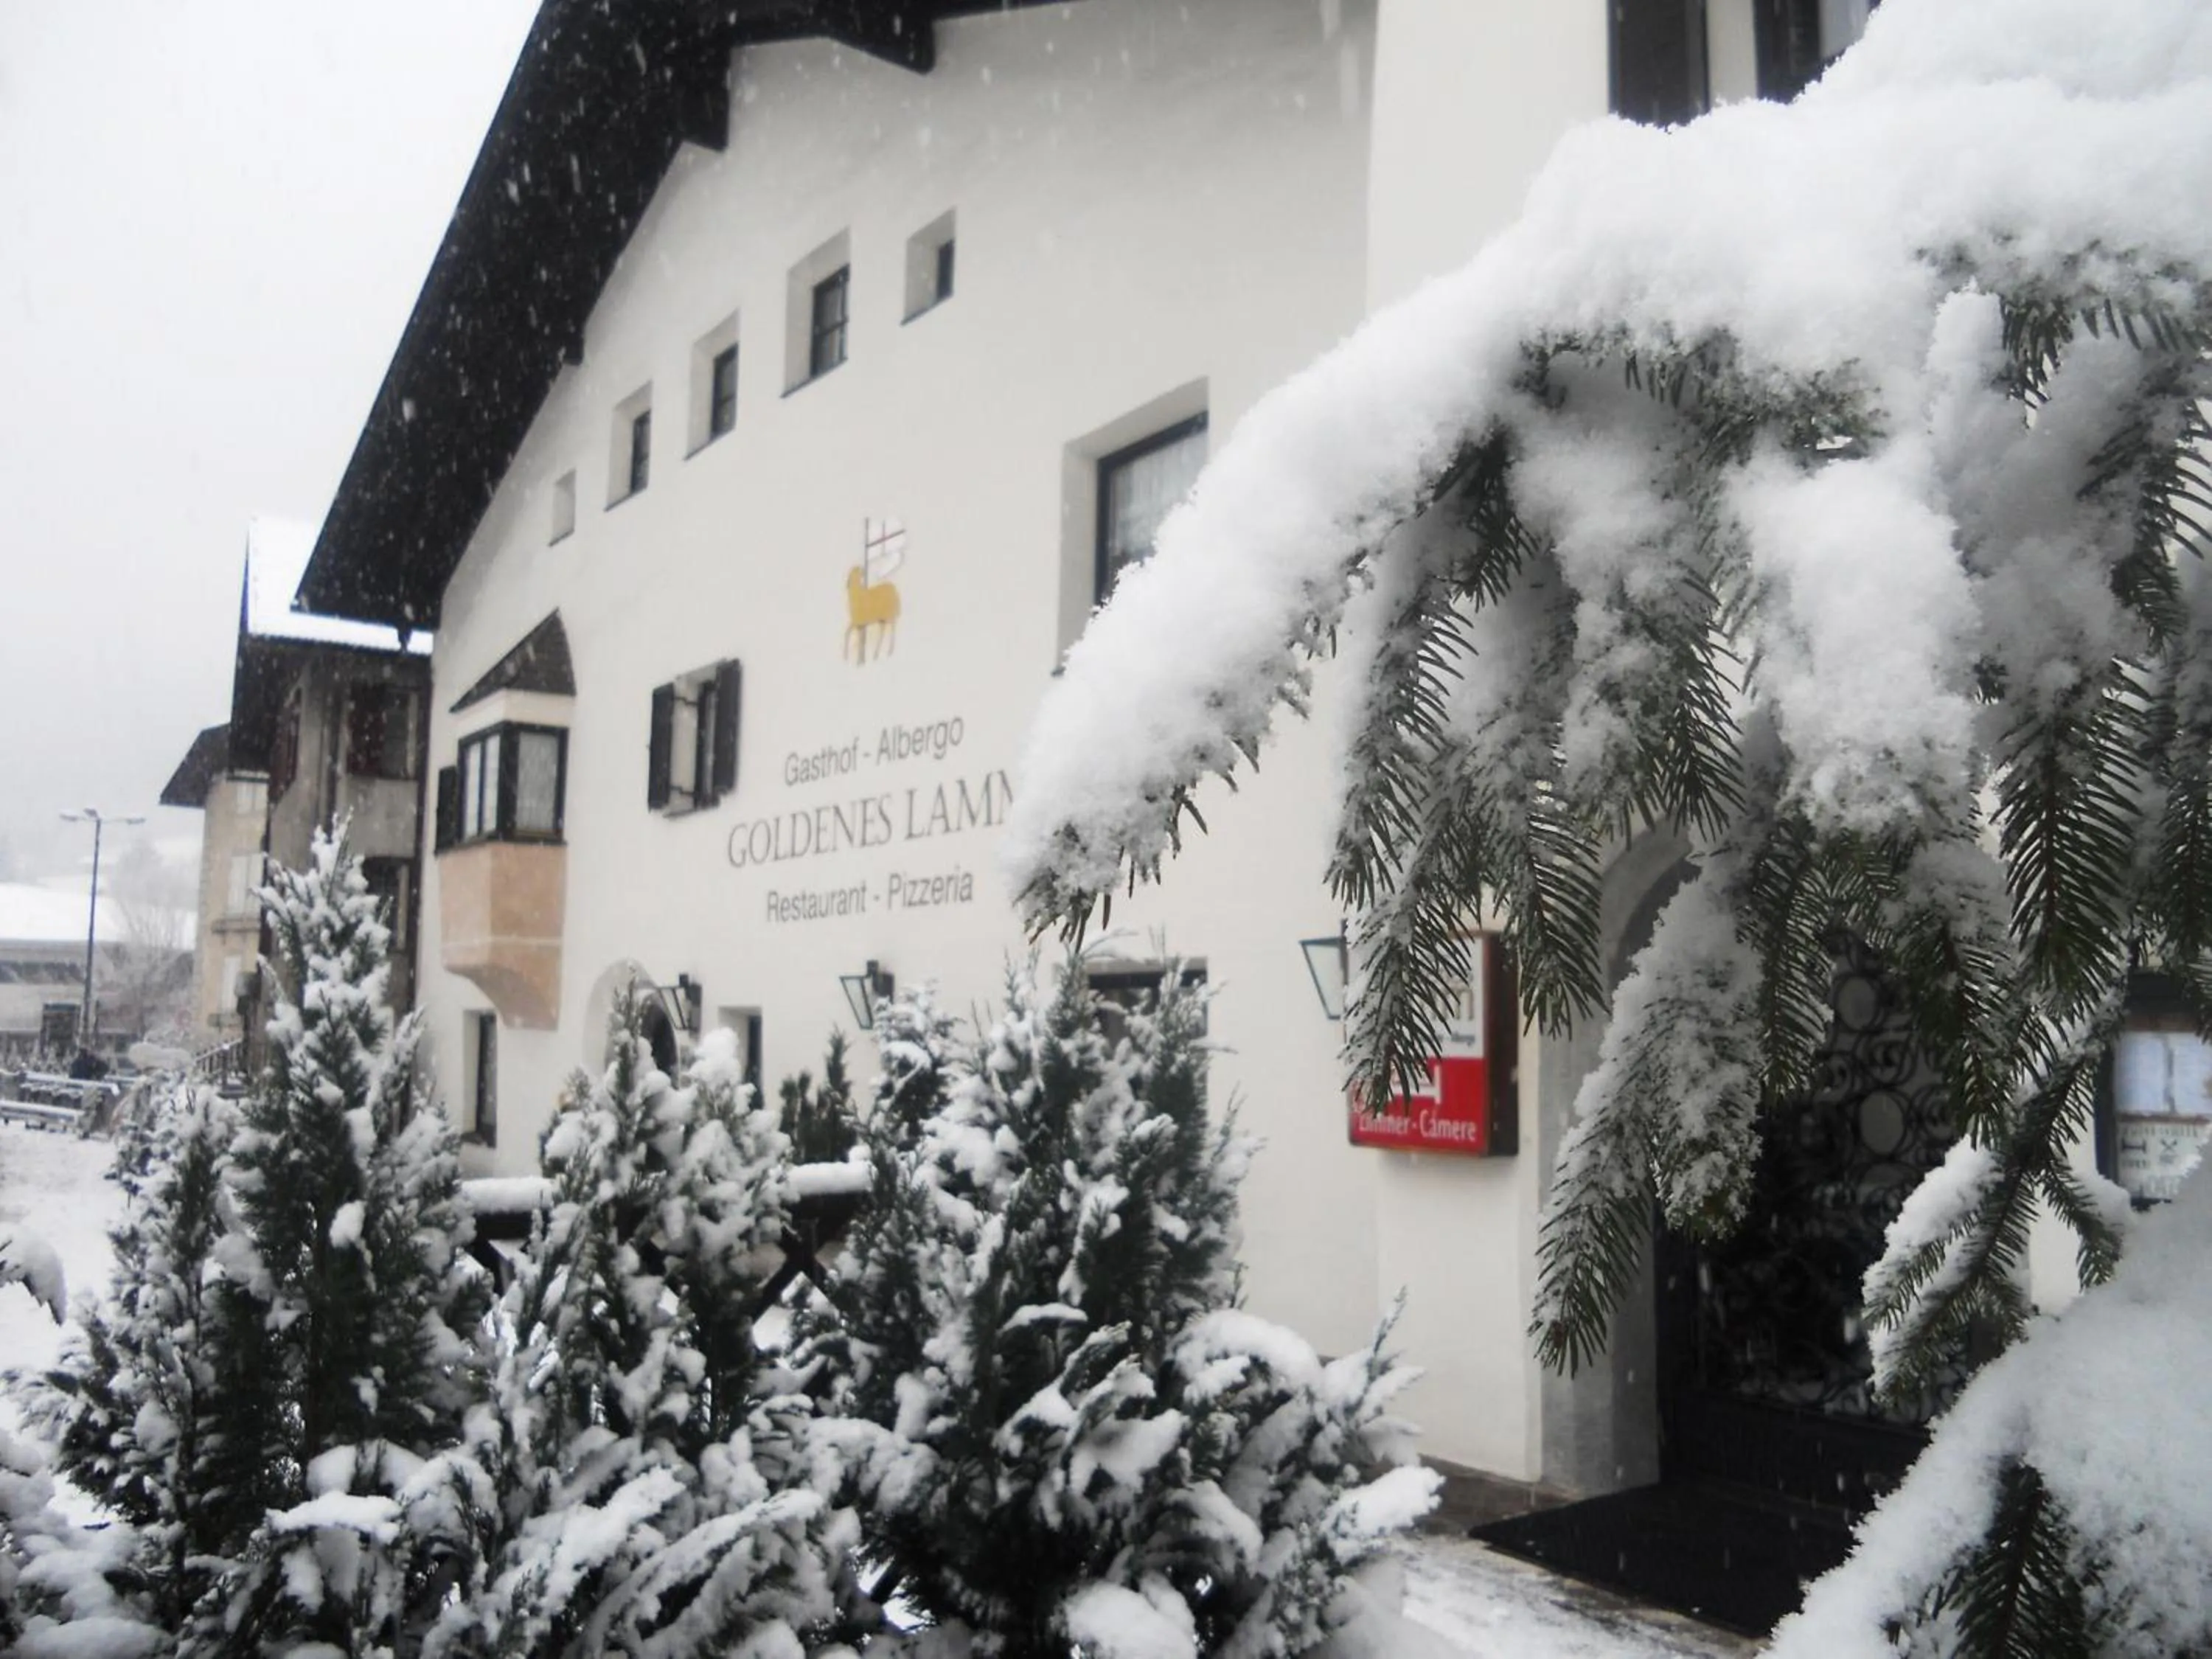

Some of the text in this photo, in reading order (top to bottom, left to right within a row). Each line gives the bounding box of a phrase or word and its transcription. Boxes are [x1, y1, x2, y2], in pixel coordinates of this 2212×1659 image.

[785, 736, 860, 787] Gasthof
[876, 716, 964, 766] Albergo
[728, 793, 892, 869] GOLDENES
[767, 879, 867, 923] Restaurant
[888, 863, 973, 911] Pizzeria
